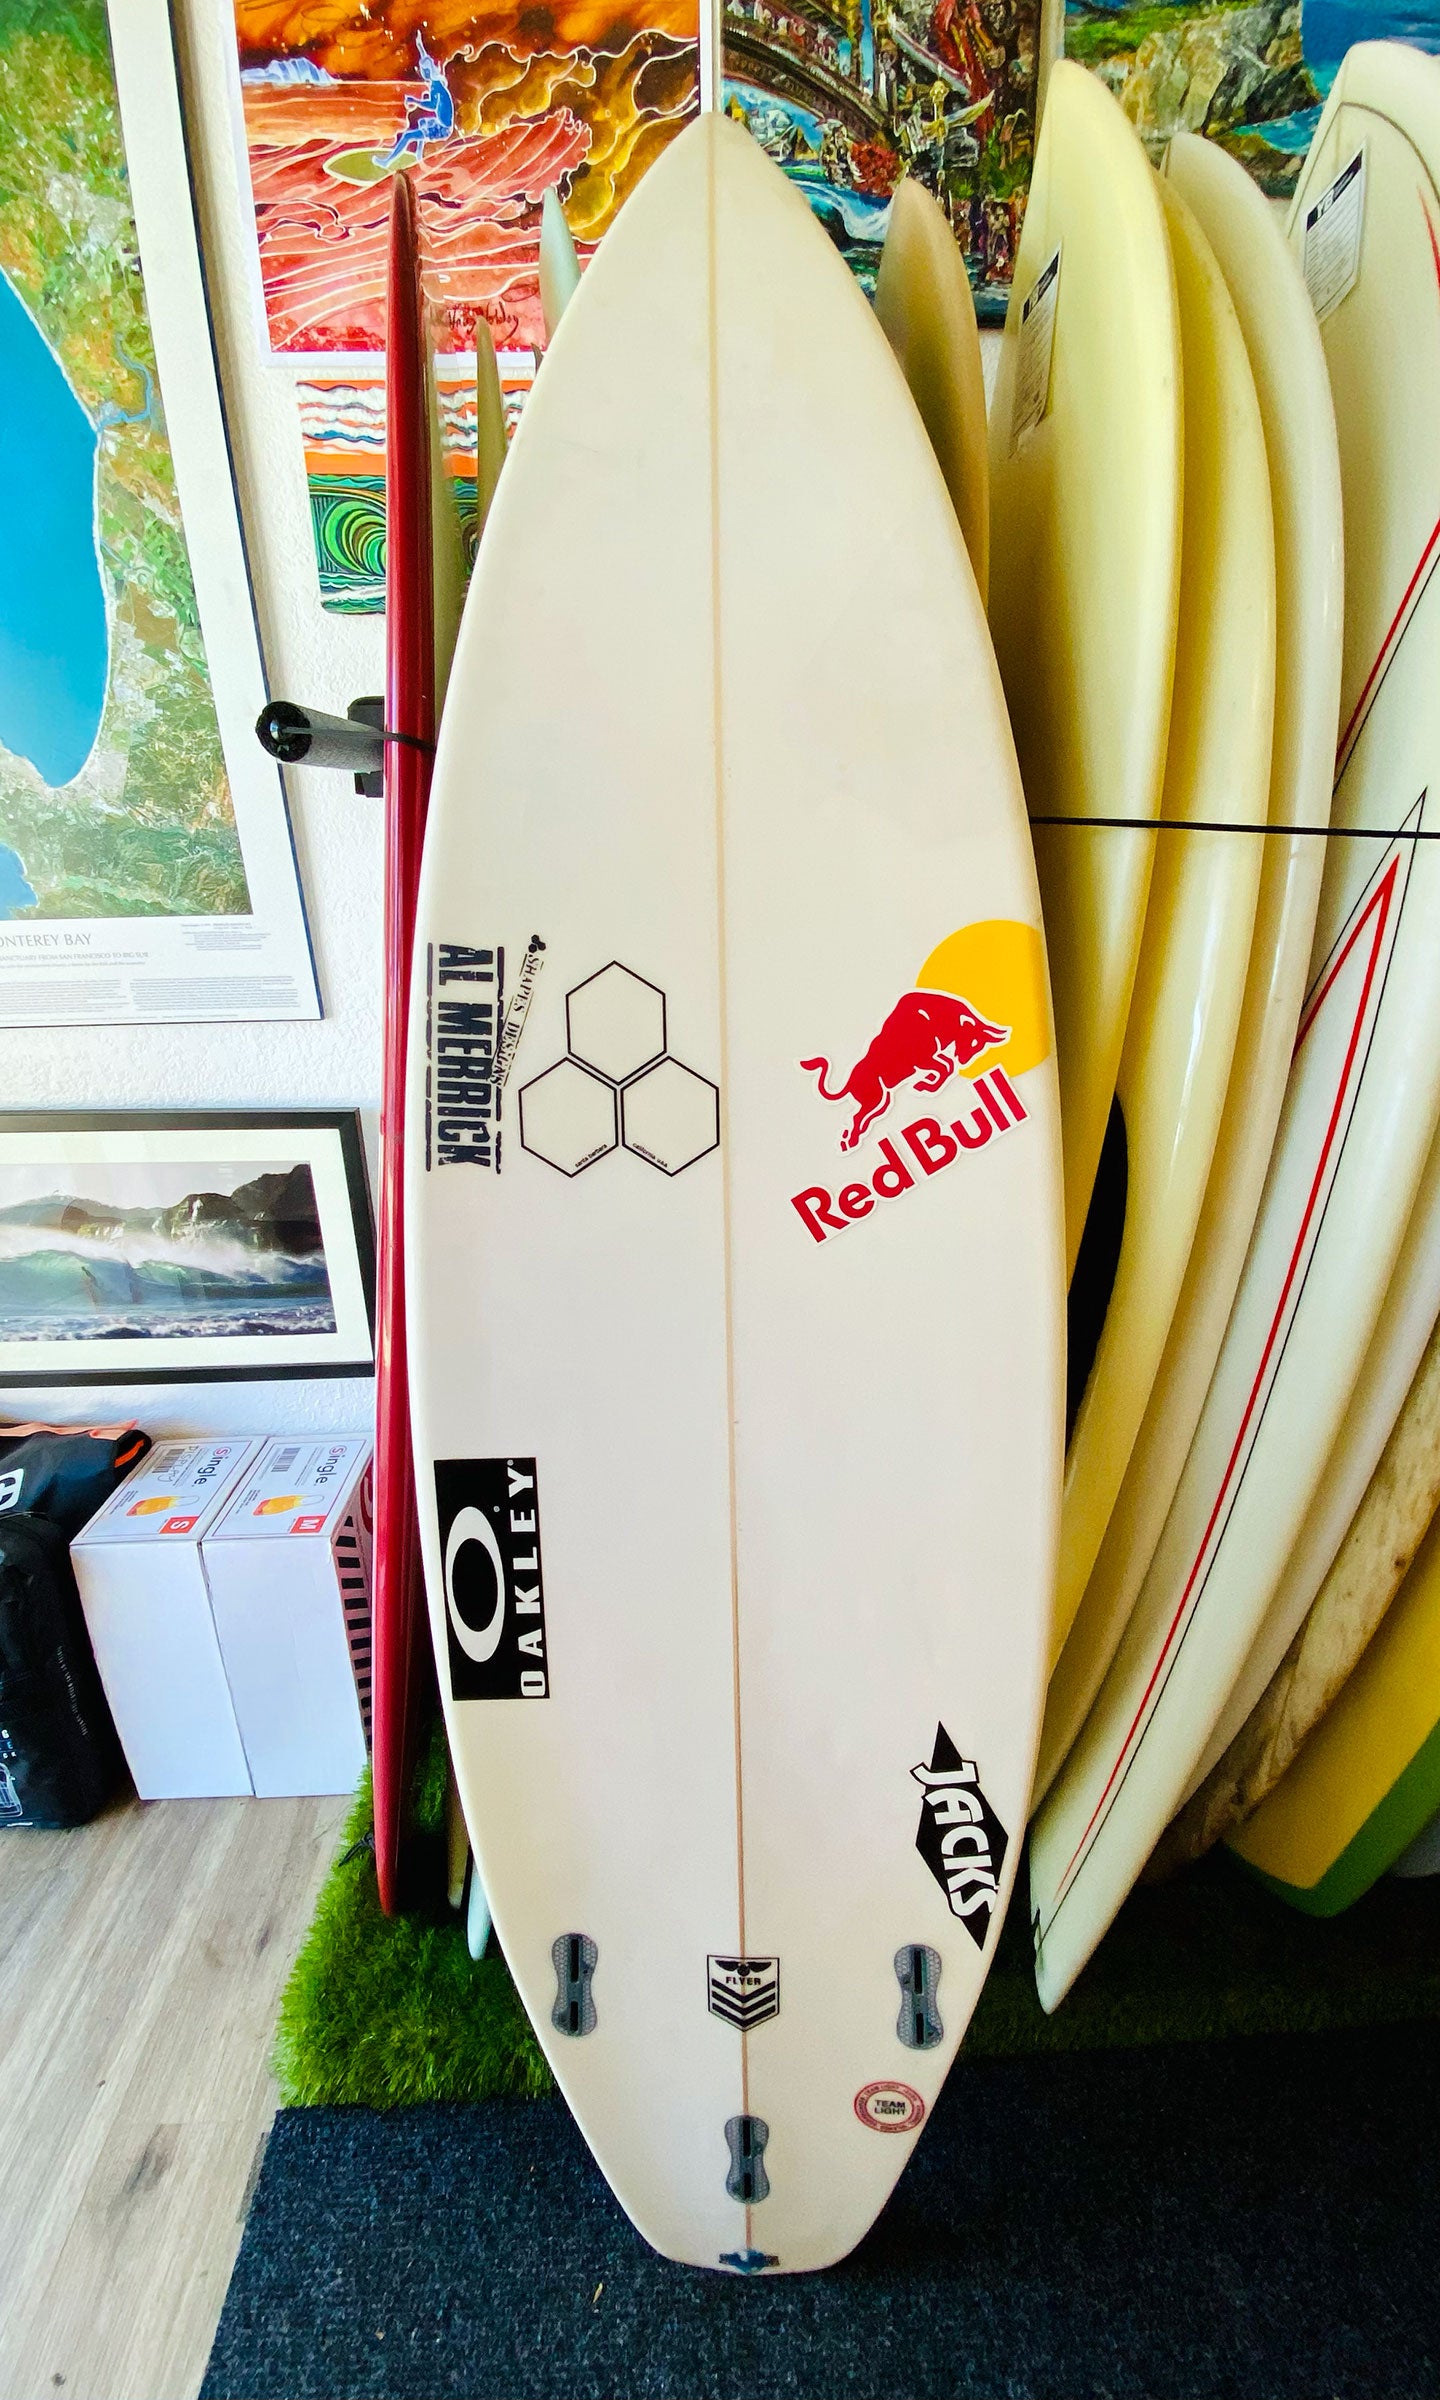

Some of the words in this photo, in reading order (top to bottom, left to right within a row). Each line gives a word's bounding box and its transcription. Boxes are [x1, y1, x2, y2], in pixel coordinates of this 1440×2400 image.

[64, 933, 91, 946] BAY
[438, 943, 494, 986] AL
[513, 954, 540, 1012] SHAPES
[437, 1001, 493, 1167] MERRICK
[790, 1137, 915, 1243] Red
[901, 1068, 1028, 1176] Bull
[169, 1520, 190, 1530] S
[299, 1519, 320, 1530] M
[507, 1466, 546, 1697] OAKLEY
[725, 1976, 761, 1986] FLYER
[874, 2099, 906, 2109] TEAM
[874, 2107, 906, 2116] LIGHT
